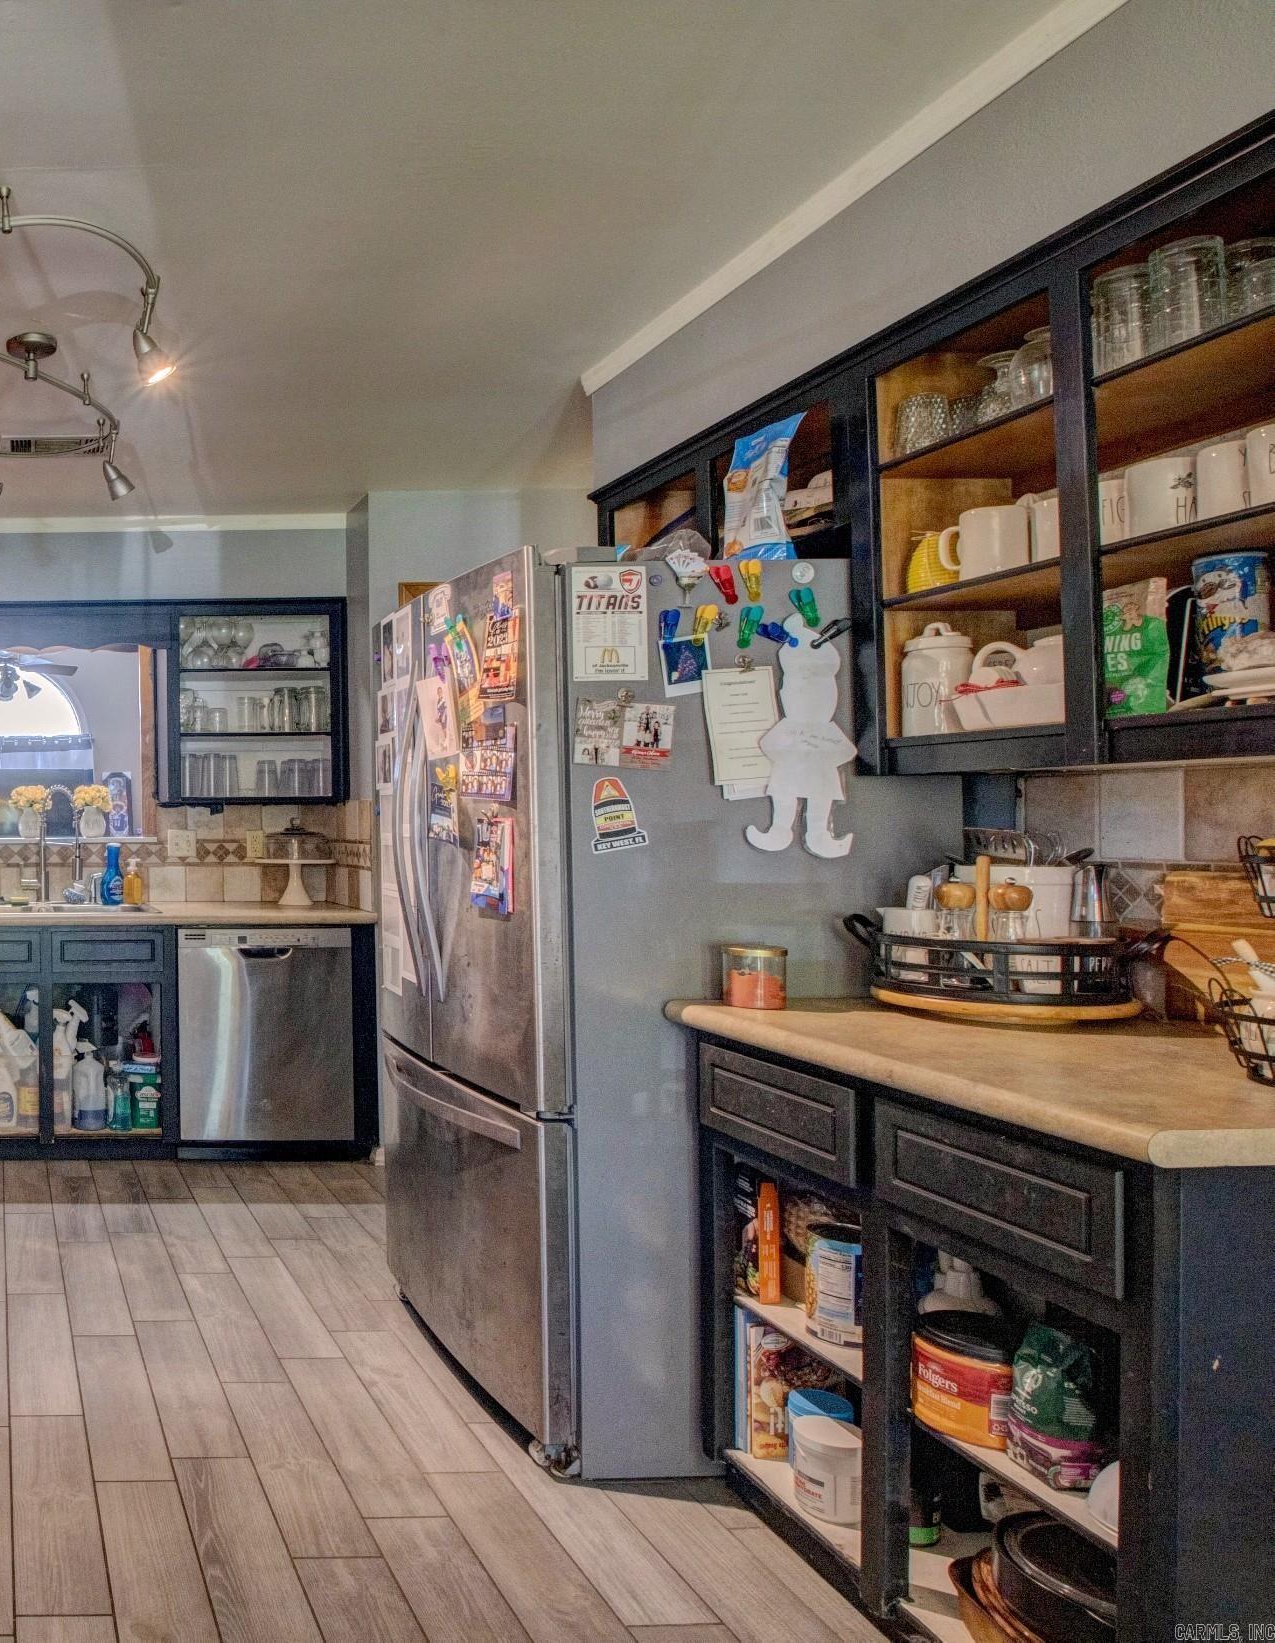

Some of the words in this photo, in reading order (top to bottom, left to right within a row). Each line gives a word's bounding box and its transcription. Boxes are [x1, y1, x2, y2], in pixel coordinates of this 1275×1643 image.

[575, 594, 642, 611] TITANS
[1107, 652, 1128, 672] ES
[903, 681, 941, 709] NJOY
[604, 813, 624, 822] POINT
[596, 842, 612, 850] KEY
[635, 836, 644, 844] FL
[918, 1361, 958, 1393] Folgers
